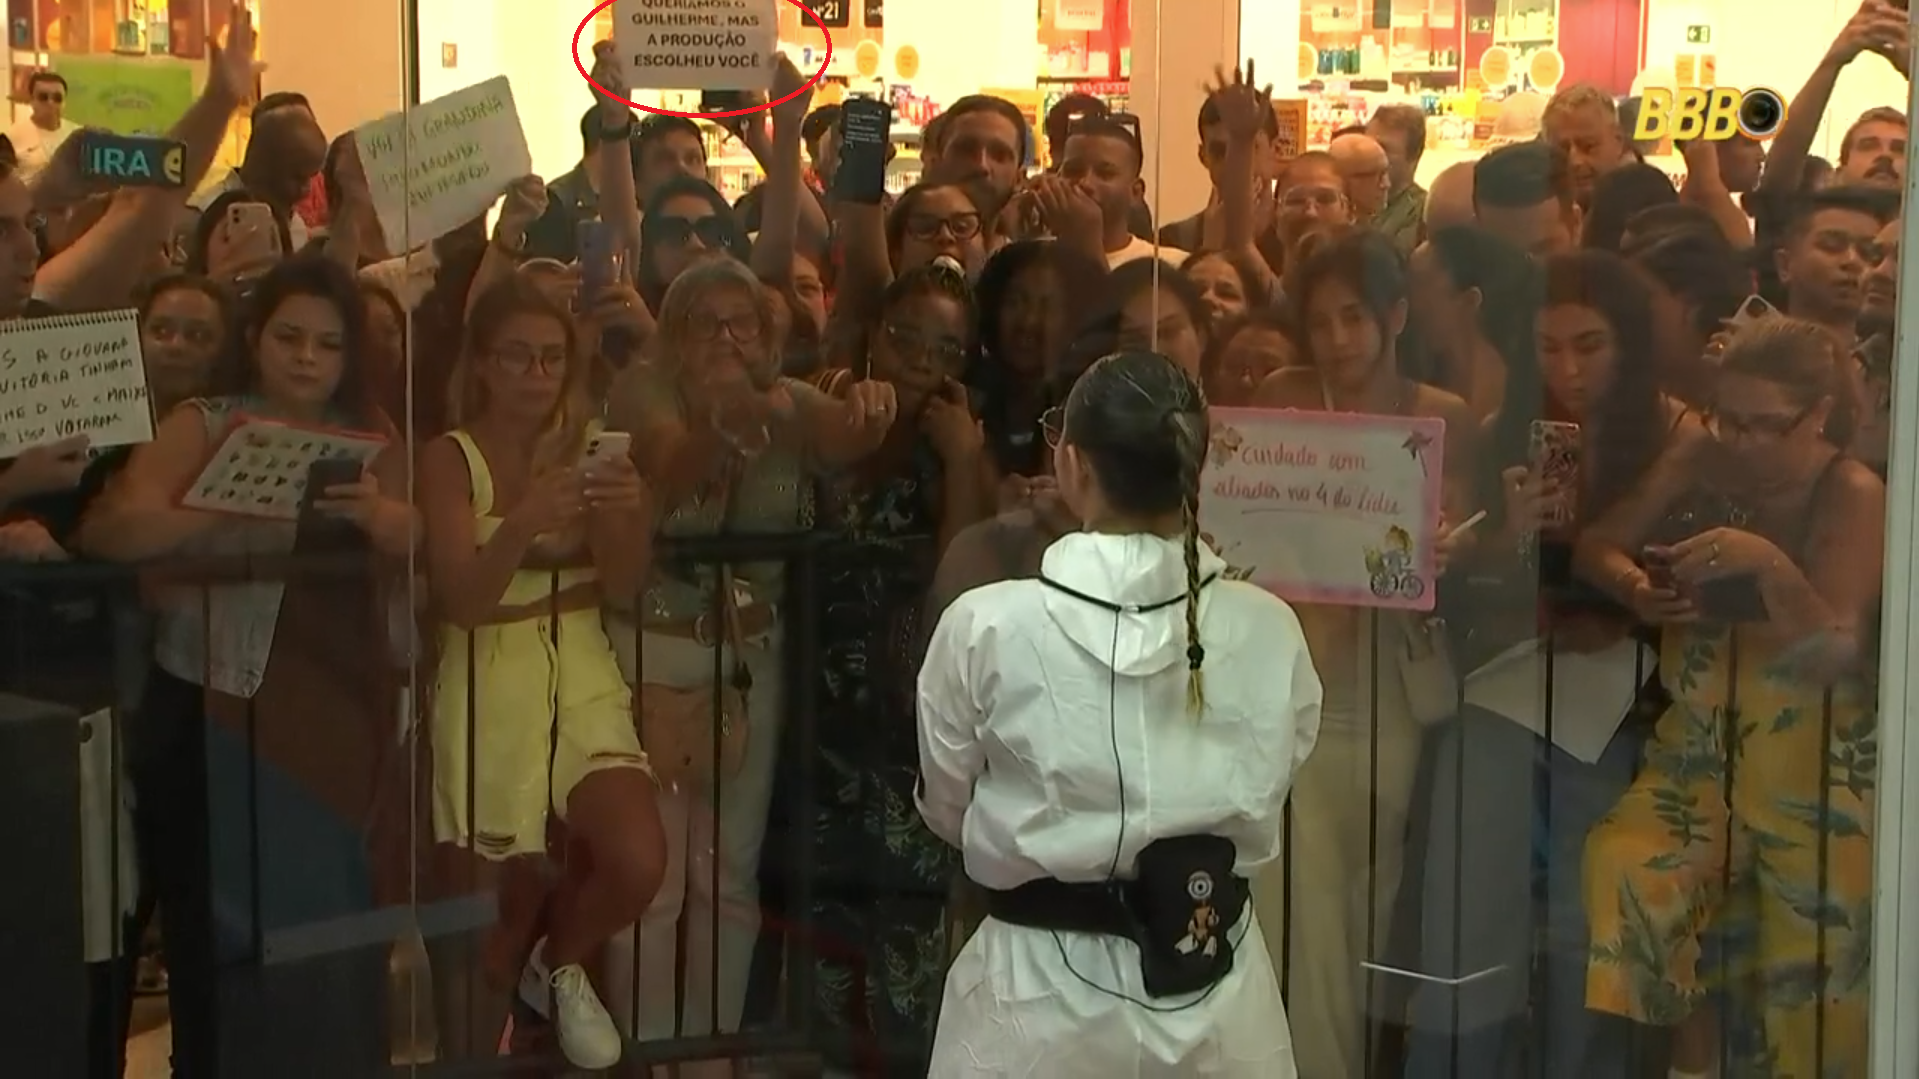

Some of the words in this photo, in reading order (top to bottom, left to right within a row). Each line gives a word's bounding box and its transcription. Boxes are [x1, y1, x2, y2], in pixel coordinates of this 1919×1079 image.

[728, 14, 759, 26] MAS
[647, 33, 657, 46] A
[661, 29, 746, 49] PRODUÇÃO
[634, 53, 715, 67] ESCOLHEU
[718, 51, 760, 67] VOCÊ
[36, 348, 48, 363] A
[1288, 485, 1310, 502] no
[1316, 482, 1328, 508] 4
